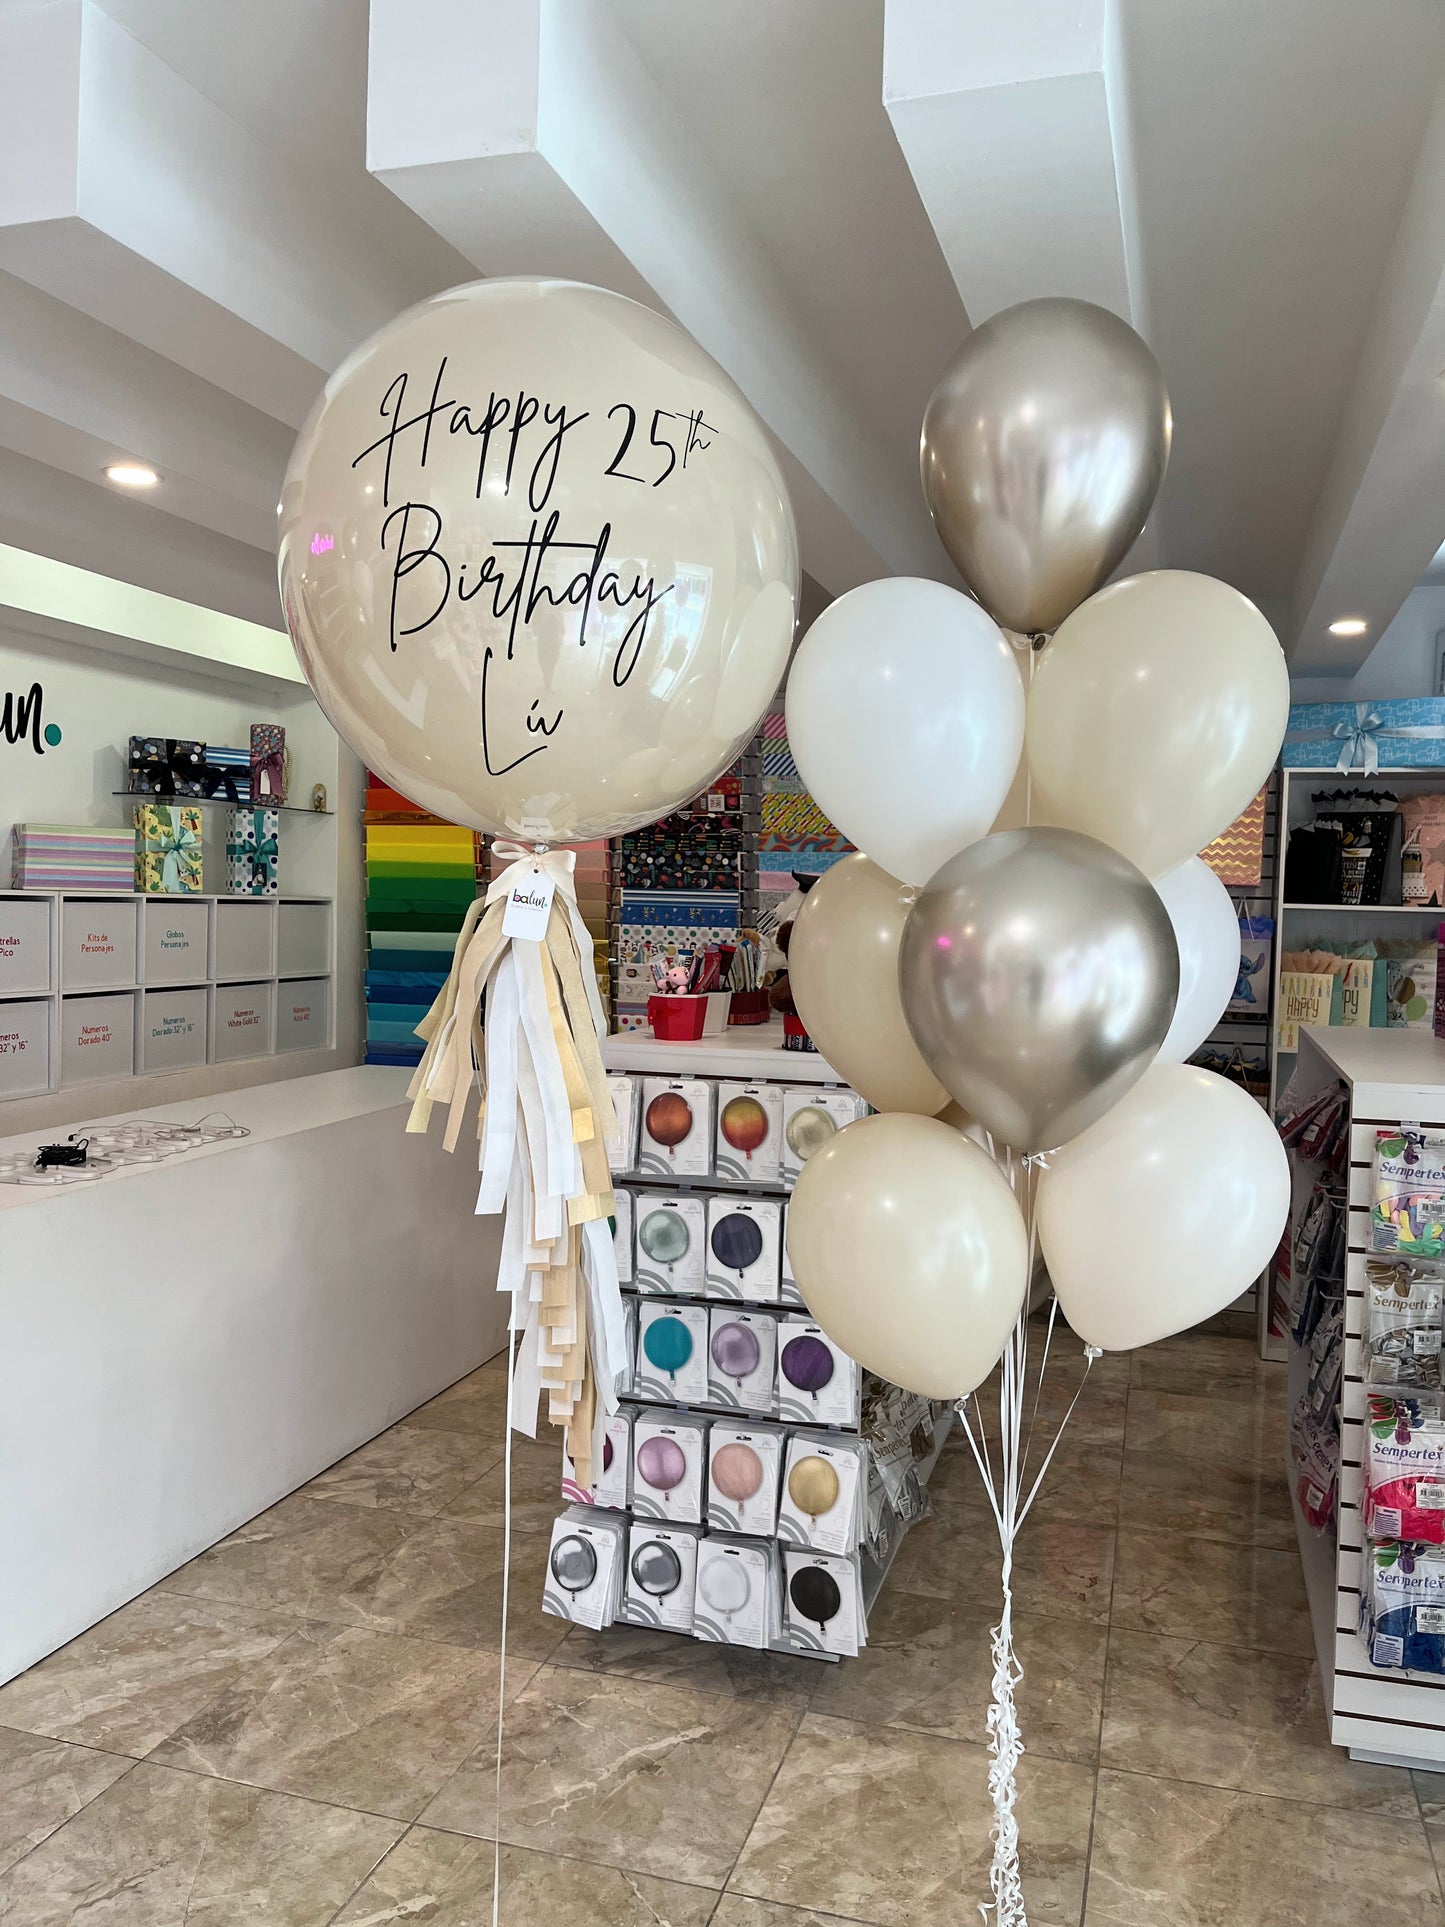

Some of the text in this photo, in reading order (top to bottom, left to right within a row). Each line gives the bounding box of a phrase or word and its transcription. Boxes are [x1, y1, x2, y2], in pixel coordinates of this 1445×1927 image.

[352, 356, 720, 513] Happy 25th
[380, 501, 675, 687] Birthday
[481, 646, 564, 776] Liv
[87, 933, 108, 942] Kits de
[166, 930, 184, 939] Globos
[81, 944, 114, 954] Personajes
[160, 940, 189, 950] Personajes
[1286, 996, 1319, 1018] HAPPY
[163, 1017, 185, 1026] Numeros
[82, 1025, 109, 1034] Numeros
[152, 1027, 172, 1037] Dorado
[78, 1036, 101, 1046] Dorado
[12, 1044, 17, 1054] y
[1373, 1295, 1440, 1312] Sempertex
[1373, 1442, 1443, 1461] Sempertex
[1377, 1570, 1445, 1589] Sempertex
